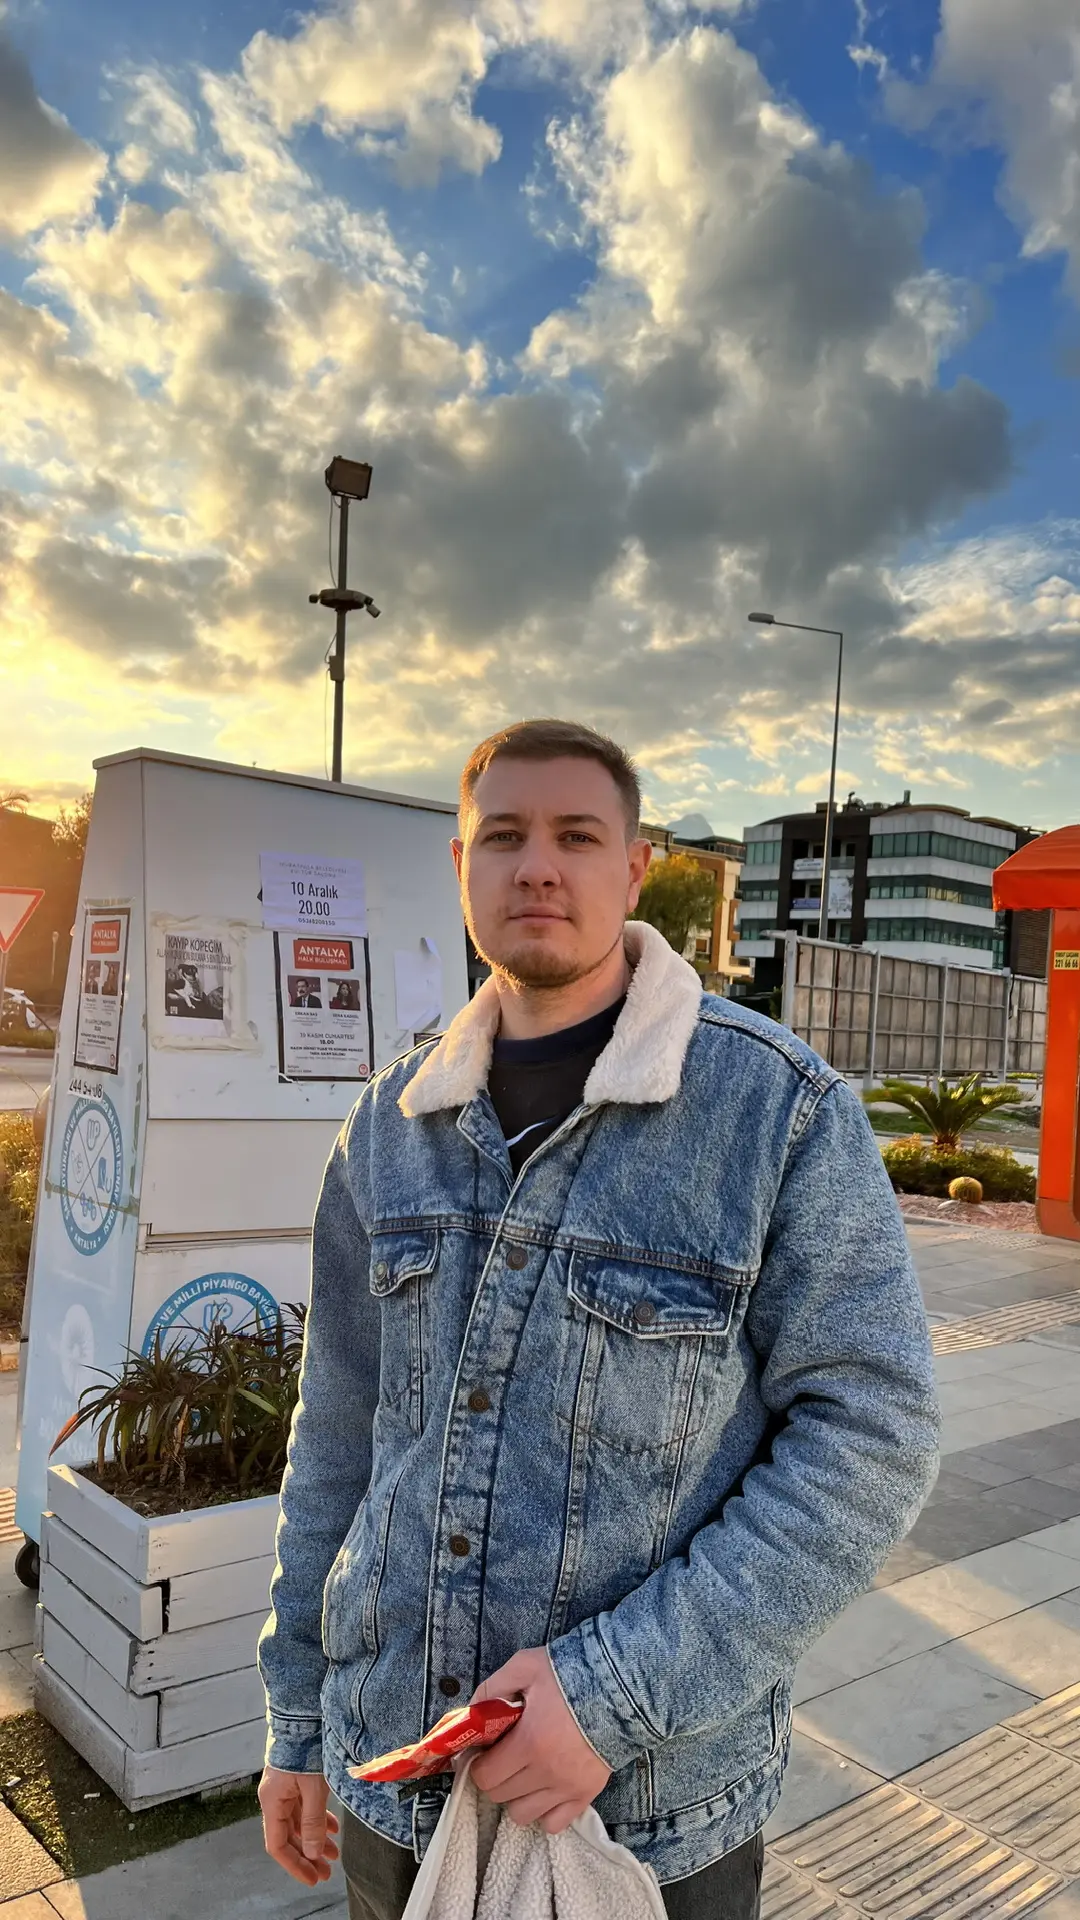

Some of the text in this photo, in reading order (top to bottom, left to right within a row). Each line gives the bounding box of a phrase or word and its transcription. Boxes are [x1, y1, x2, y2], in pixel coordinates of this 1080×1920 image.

[291, 881, 339, 899] 10 Aralık
[298, 900, 331, 916] 20.00
[93, 930, 117, 939] ANTALYA
[168, 935, 223, 953] KAYIP KÖPEĞİM
[299, 945, 346, 958] ANTALYA
[315, 957, 348, 965] BULUŞMASI
[74, 1233, 97, 1250] ANTALYA
[160, 1306, 175, 1322] VE
[173, 1282, 202, 1309] MİLLİ
[202, 1278, 249, 1293] PİYANGO
